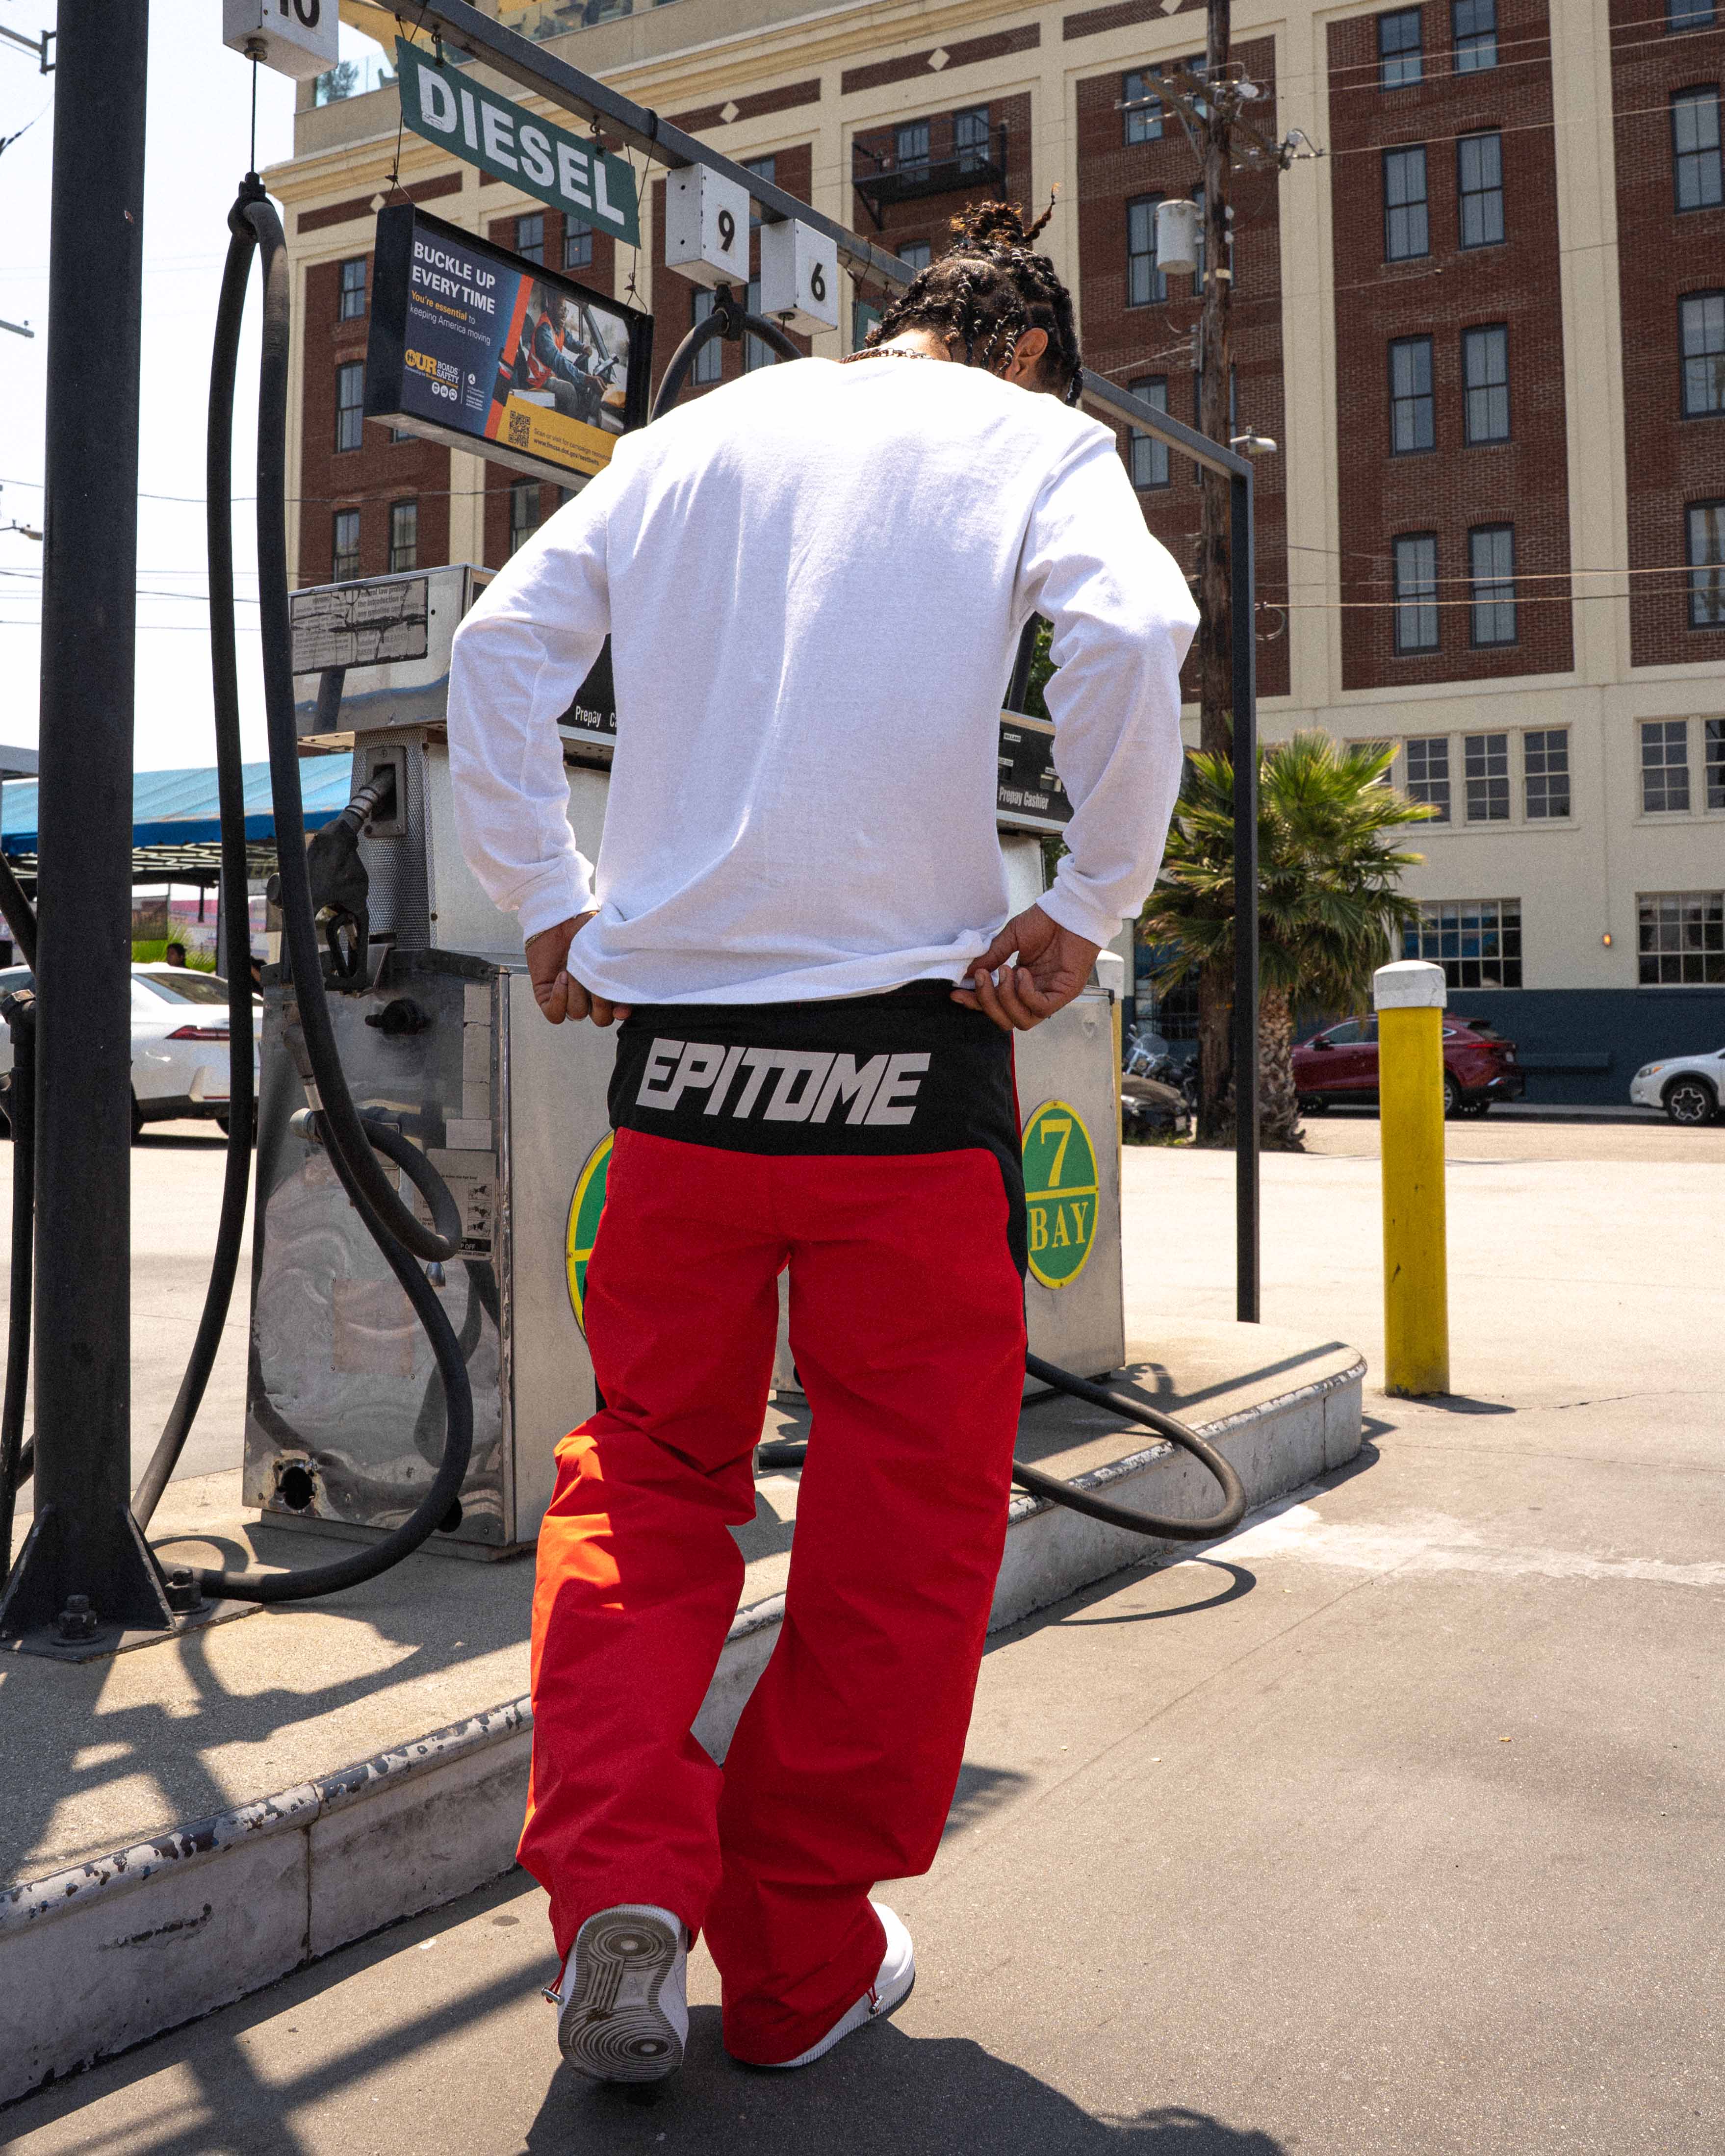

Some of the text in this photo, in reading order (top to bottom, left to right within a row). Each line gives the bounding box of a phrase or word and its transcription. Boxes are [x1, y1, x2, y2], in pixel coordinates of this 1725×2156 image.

[417, 63, 624, 226] DIESEL
[718, 210, 735, 252] 9
[414, 241, 496, 289] BUCKLE UP
[810, 262, 825, 302] 6
[412, 265, 495, 314] EVERY TIME
[412, 290, 475, 325] You're essential to
[410, 304, 490, 346] keeping America moving
[405, 349, 437, 375] OUR
[437, 369, 459, 384] SAFETY
[575, 705, 601, 727] Prepay
[999, 786, 1049, 810] Prepay Cashier
[635, 1037, 931, 1125] EPITOME
[1040, 1118, 1072, 1187] 7
[1029, 1202, 1088, 1251] BAY
